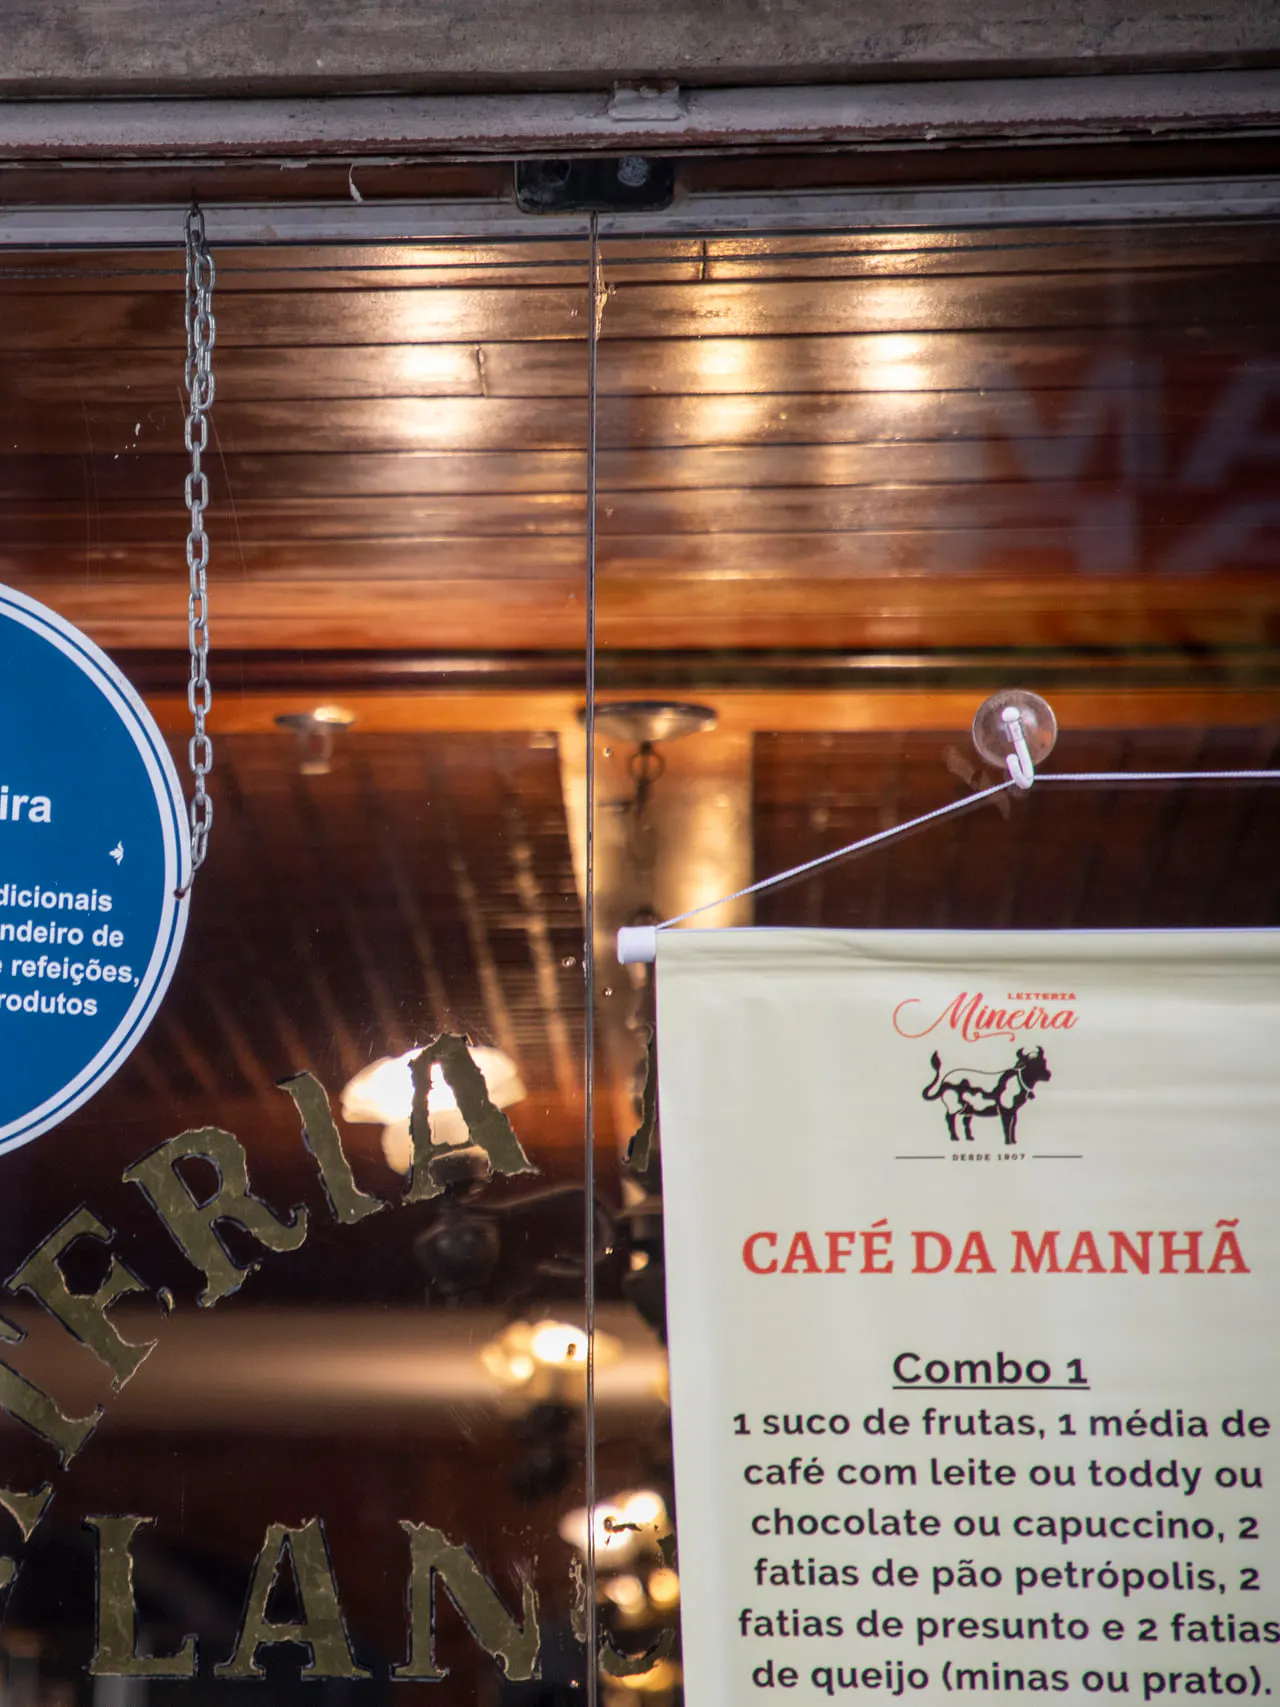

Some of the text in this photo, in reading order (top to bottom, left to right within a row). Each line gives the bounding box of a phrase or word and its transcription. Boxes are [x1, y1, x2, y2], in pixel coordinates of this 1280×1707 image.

[91, 923, 124, 948] de
[11, 955, 140, 988] refeições,
[1007, 992, 1077, 1001] LEITERIA
[893, 991, 1079, 1043] Mineira
[952, 1153, 1027, 1161] DESDE 1907
[742, 1218, 1252, 1275] CAFÉ DA MANHÃ
[893, 1351, 1088, 1385] Combo 1
[733, 1407, 1272, 1440] 1 suco de frutas, 1 média de
[743, 1456, 1264, 1497] café com leite ou toddy ou
[751, 1507, 1260, 1545] chocolate ou capuccino, 2
[754, 1557, 1261, 1598] fatias de pão petrópolis, 2
[738, 1608, 1280, 1647] fatias de presunto e 2 fatias
[751, 1659, 1272, 1702] de queijo (minas ou prato).
